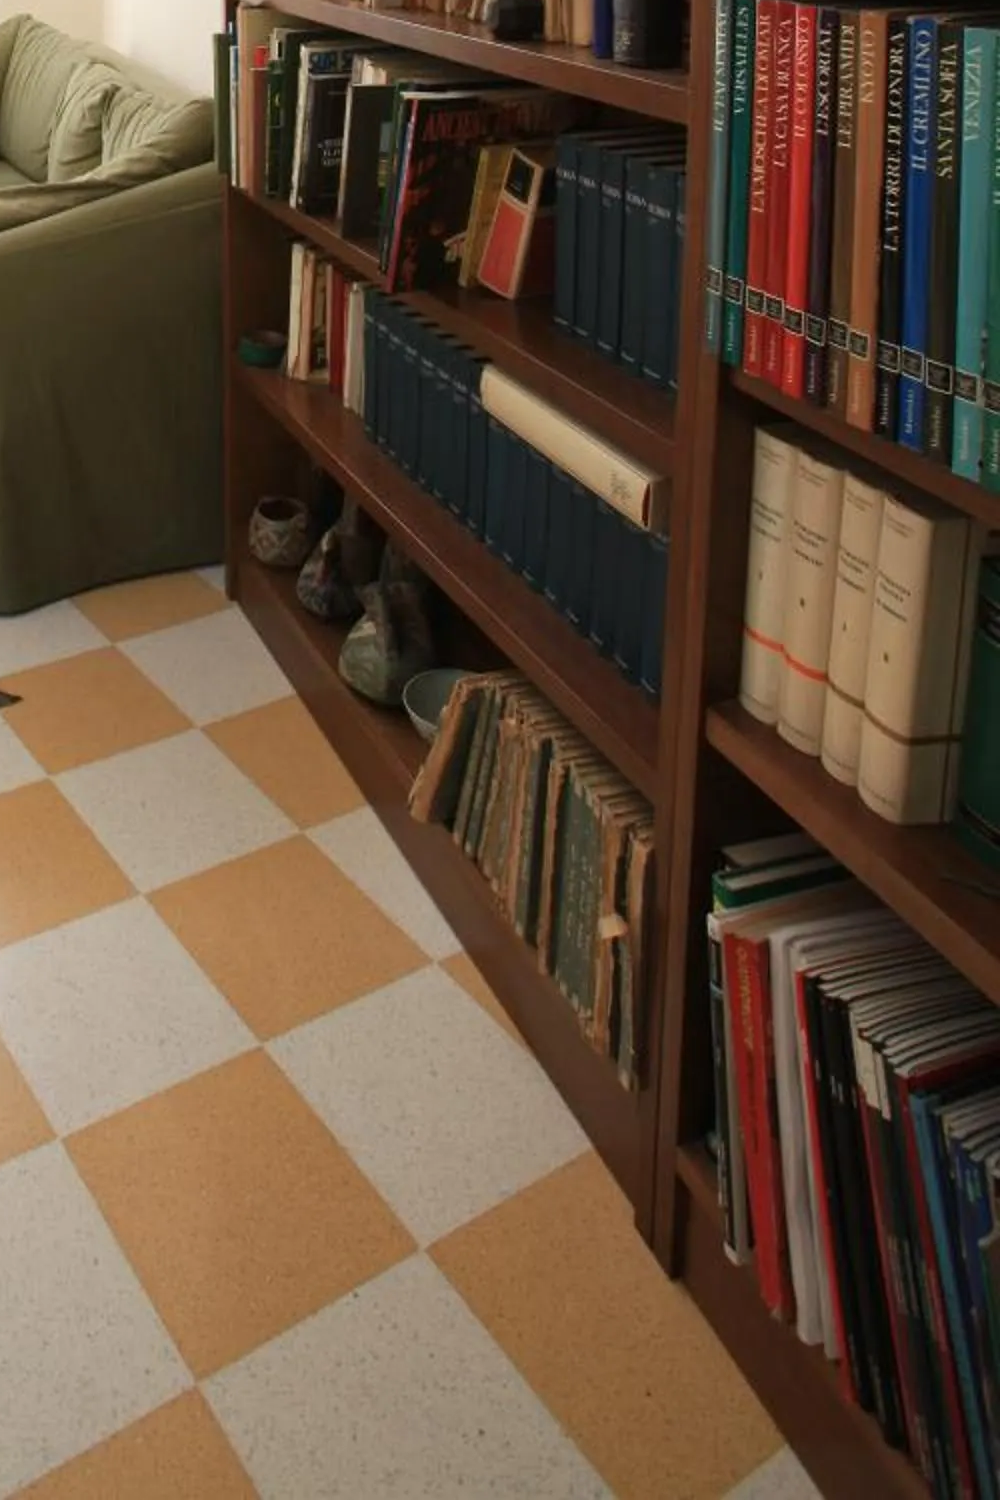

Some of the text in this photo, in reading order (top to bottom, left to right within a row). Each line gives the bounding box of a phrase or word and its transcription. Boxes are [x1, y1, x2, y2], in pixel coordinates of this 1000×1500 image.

[733, 6, 750, 115] VERSAILLES
[837, 24, 856, 149] LE PIRAMIDI
[860, 28, 877, 104] KYOTO
[887, 31, 906, 120] LONDRA
[911, 29, 932, 172] IL CREMLINO
[964, 45, 982, 143] VENEZIA
[775, 92, 790, 140] CASA
[936, 41, 958, 180] SANTA SOFIA
[884, 150, 902, 224] TORRE
[883, 225, 899, 253] LA
